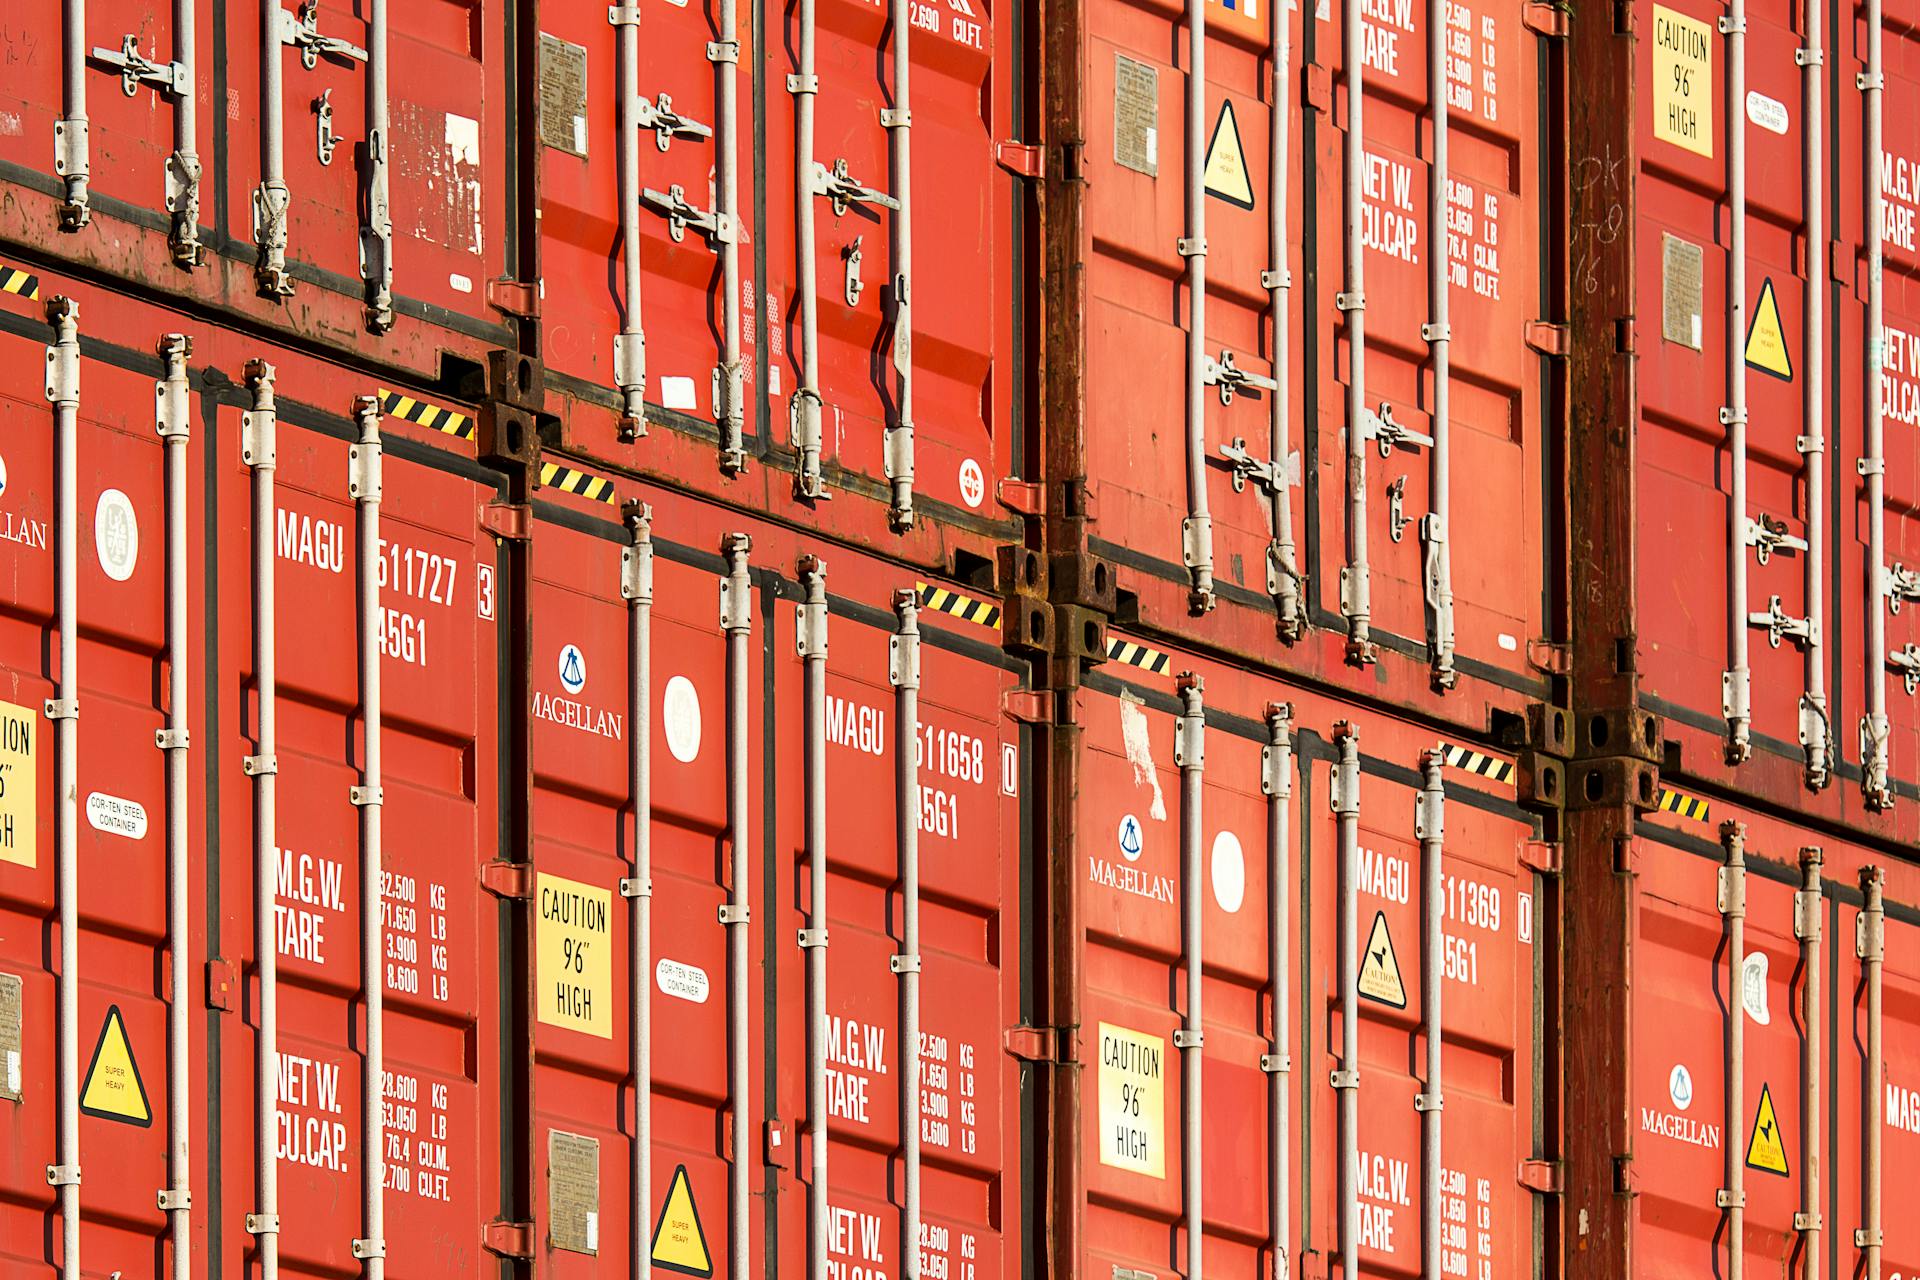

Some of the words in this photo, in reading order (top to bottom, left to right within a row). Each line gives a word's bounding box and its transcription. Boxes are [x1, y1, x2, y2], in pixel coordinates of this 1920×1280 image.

[1481, 15, 1495, 42] KG
[1657, 17, 1707, 63] CAUTION
[1360, 20, 1399, 77] TARE
[1481, 41, 1496, 68] LB
[1482, 67, 1496, 95] KG
[1483, 95, 1497, 122] LB
[1669, 102, 1696, 140] HIGH
[1361, 150, 1390, 202] NET
[1391, 161, 1414, 212] W.
[1484, 192, 1498, 220] KG
[1361, 201, 1418, 265] CU.CAP.
[1483, 219, 1497, 246] LB
[1880, 198, 1916, 253] TARE
[1881, 324, 1907, 373] NET
[277, 508, 344, 573] MAGU
[378, 538, 457, 607] 511727
[479, 567, 493, 617] 3
[378, 606, 427, 667] 45G1
[531, 691, 623, 740] MAGELLAN
[825, 695, 884, 756] MAGU
[90, 796, 121, 814] COR-TEN
[124, 805, 144, 820] STEEL
[99, 813, 136, 833] CONTAINER
[274, 846, 345, 913] M.G.W.
[1089, 856, 1175, 905] MAGELLAN
[1356, 846, 1409, 905] MAGU
[429, 883, 446, 911] KG
[542, 887, 605, 934] CAUTION
[274, 903, 325, 965] TARE
[430, 913, 447, 941] LB
[431, 944, 448, 972] KG
[432, 974, 449, 1002] LB
[660, 962, 686, 979] COR-TEN
[688, 969, 706, 985] STEEL
[667, 978, 699, 996] CONTAINER
[557, 981, 592, 1021] HIGH
[825, 1014, 887, 1075] M.G.W.
[959, 1043, 974, 1069] KG
[1104, 1036, 1159, 1079] CAUTION
[105, 1065, 125, 1077] SUPER
[105, 1079, 125, 1091] HEAVY
[275, 1051, 312, 1107] NET
[315, 1060, 342, 1114] W.
[959, 1071, 975, 1098] LB
[431, 1082, 448, 1110] KG
[825, 1069, 870, 1124] TARE
[1886, 1083, 1920, 1134] MAG
[431, 1113, 447, 1141] LB
[960, 1100, 975, 1127] KG
[1641, 1107, 1720, 1150] MAGELLAN
[276, 1109, 348, 1173] CU.CAP.
[385, 1132, 411, 1163] 76.4
[418, 1140, 451, 1172] CU.M.
[961, 1128, 976, 1154] LB
[1116, 1124, 1147, 1162] HIGH
[417, 1170, 451, 1202] CU.FT.
[1356, 1149, 1410, 1207] M.G.W.
[1476, 1177, 1490, 1203] KG
[671, 1220, 689, 1231] SUPER
[1356, 1201, 1395, 1253] TARE
[1477, 1205, 1490, 1230] LB
[671, 1233, 689, 1244] HEAVY
[826, 1204, 857, 1257] NET
[859, 1213, 883, 1263] W.
[960, 1233, 975, 1260] KG
[1477, 1231, 1491, 1257] KG
[960, 1262, 975, 1280] LB
[1478, 1258, 1492, 1280] LB
